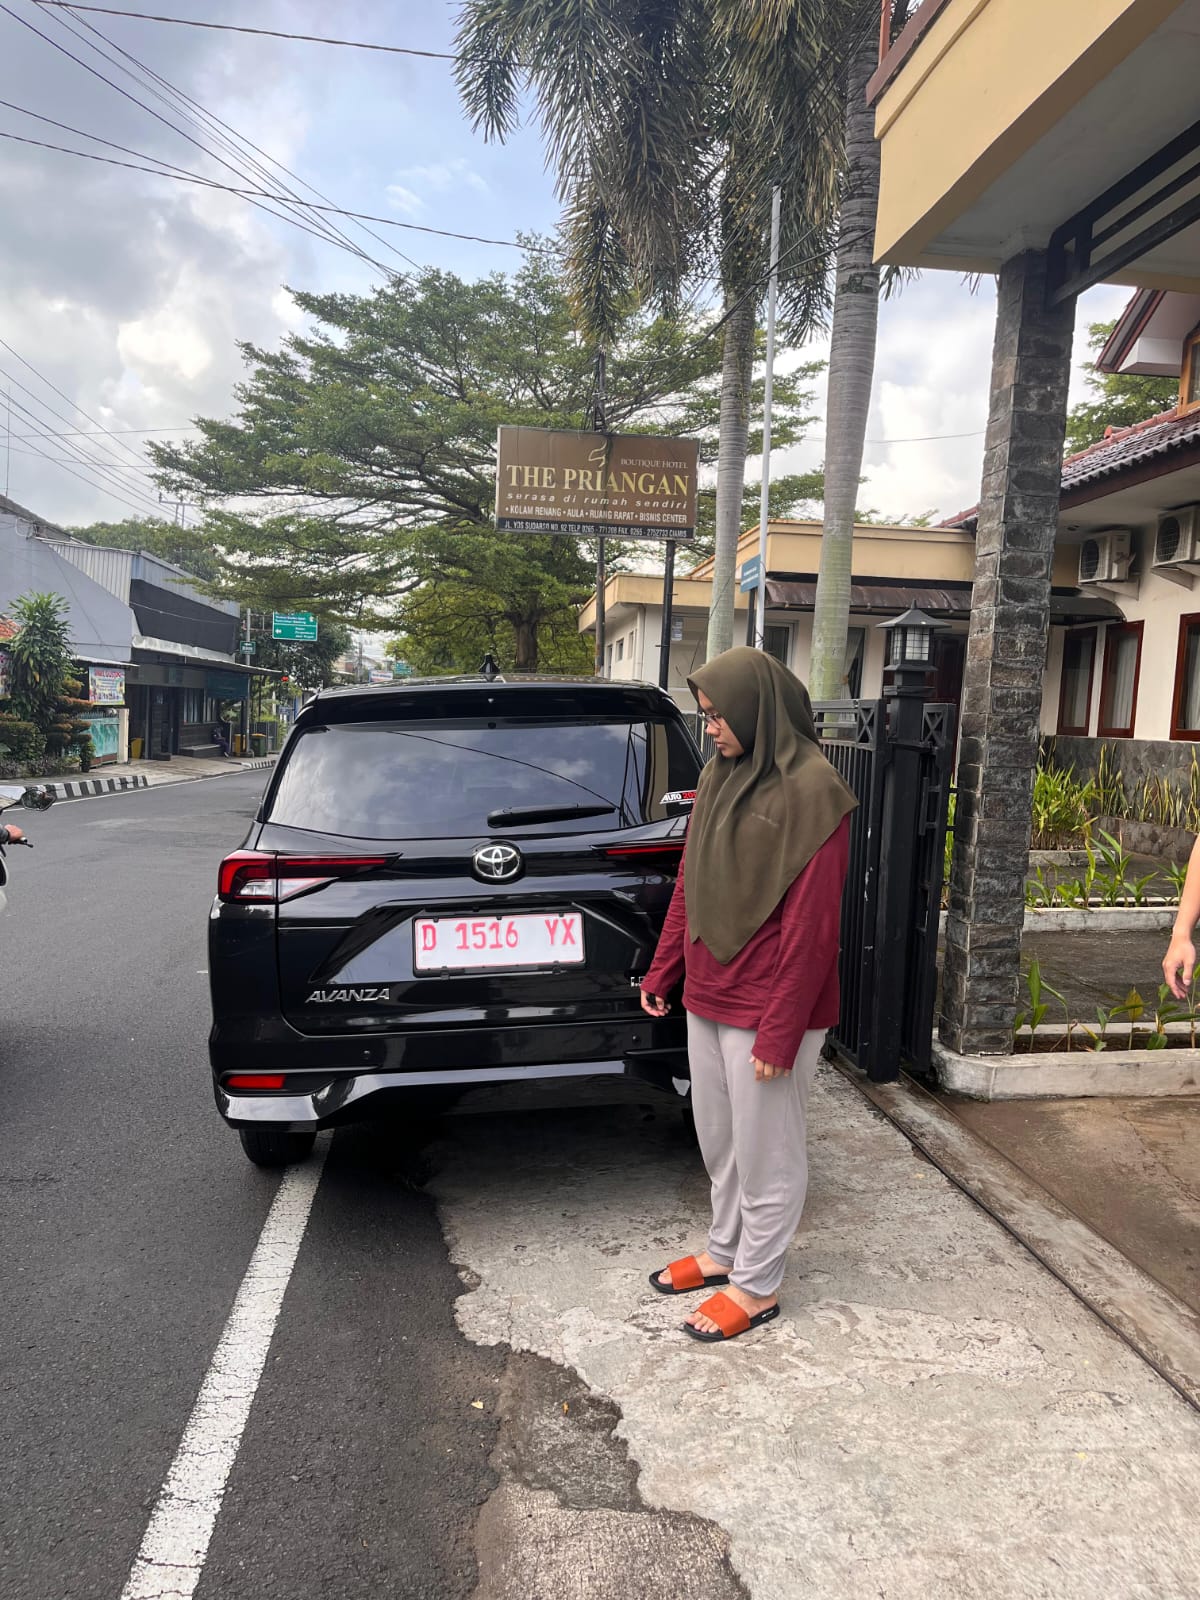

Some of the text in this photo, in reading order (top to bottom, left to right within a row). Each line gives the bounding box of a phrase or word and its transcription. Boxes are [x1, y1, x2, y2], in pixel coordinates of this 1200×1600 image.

[621, 458, 689, 469] BOUTIQUE HOTEL
[506, 464, 689, 496] THE PRIANGAN
[506, 492, 688, 509] serasa di rumah sendiri
[510, 504, 687, 524] KOLAM RENANG AULA RUANG RAPAT BISNIS CENTER
[660, 792, 682, 802] AUTO
[421, 918, 576, 951] D 1516 YX
[305, 988, 390, 1003] AVANZA
